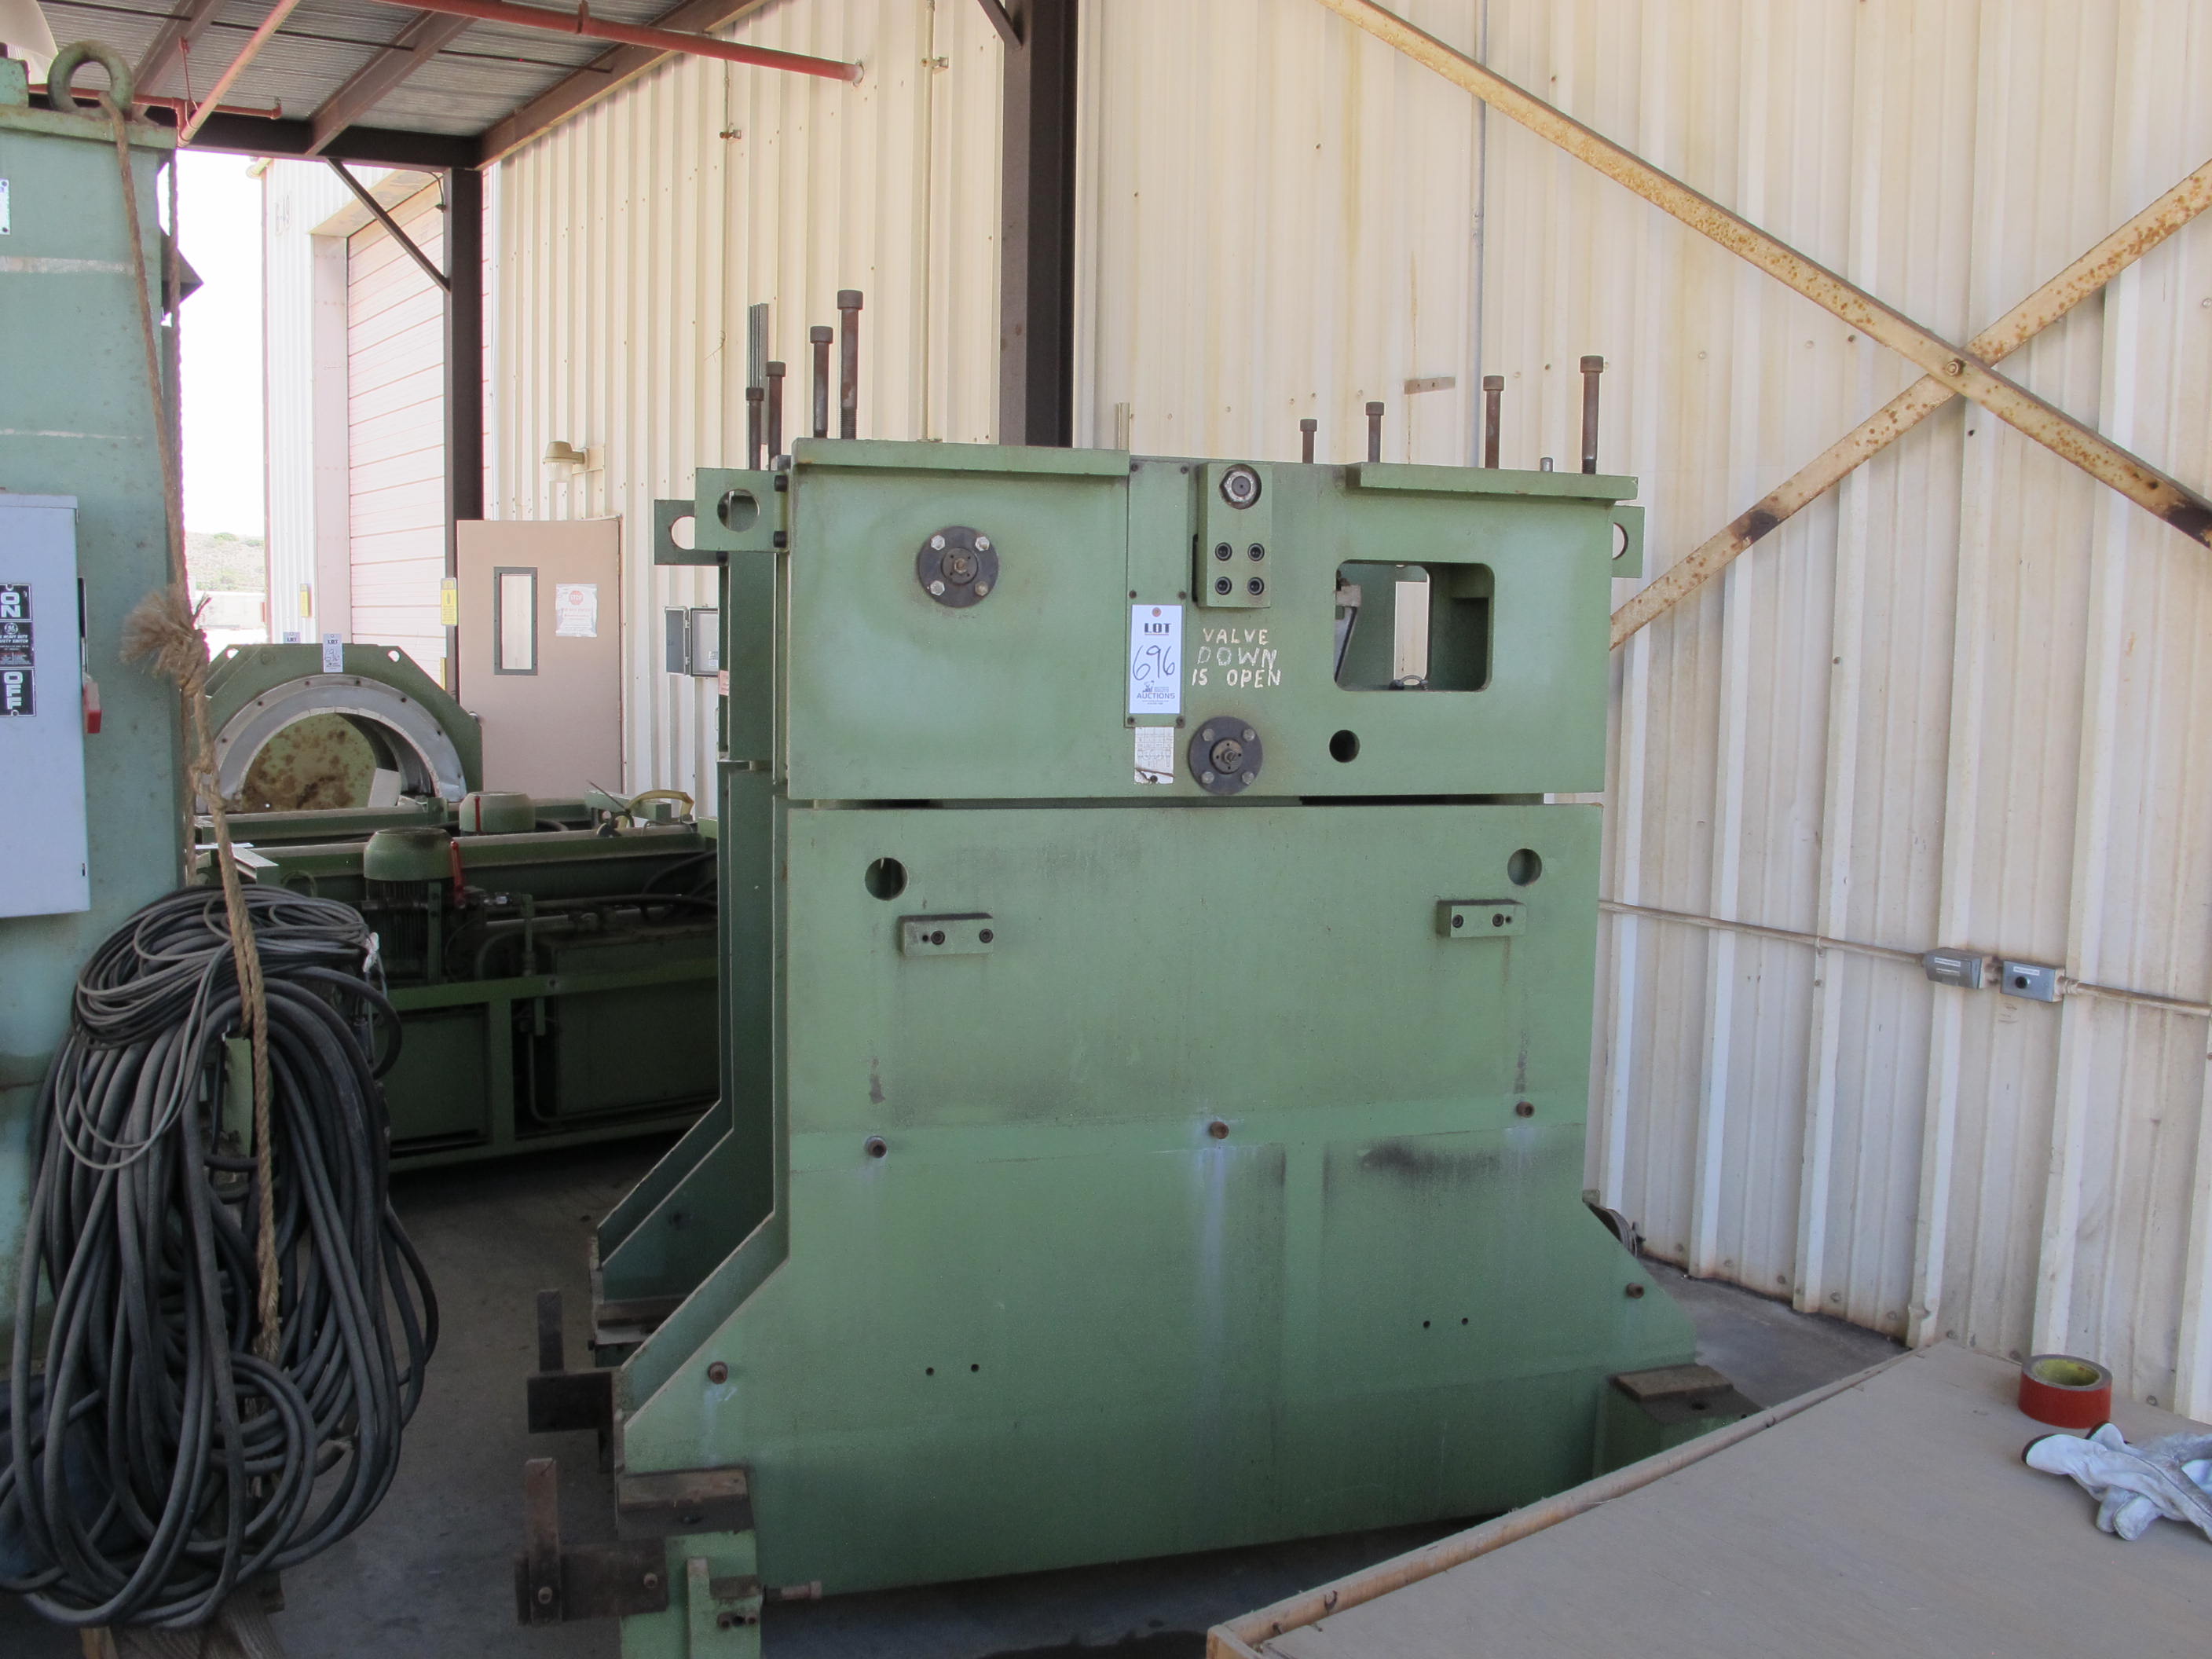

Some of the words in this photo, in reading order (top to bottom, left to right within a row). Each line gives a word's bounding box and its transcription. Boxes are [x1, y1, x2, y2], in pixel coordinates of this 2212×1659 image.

[1, 591, 20, 617] ON
[1144, 623, 1171, 633] LOT
[1203, 628, 1269, 645] VALVE
[1133, 645, 1175, 680] 696
[1197, 646, 1277, 669] DOWN
[1192, 668, 1208, 686] IS
[1226, 669, 1281, 688] OPEN
[4, 672, 23, 709] OFF
